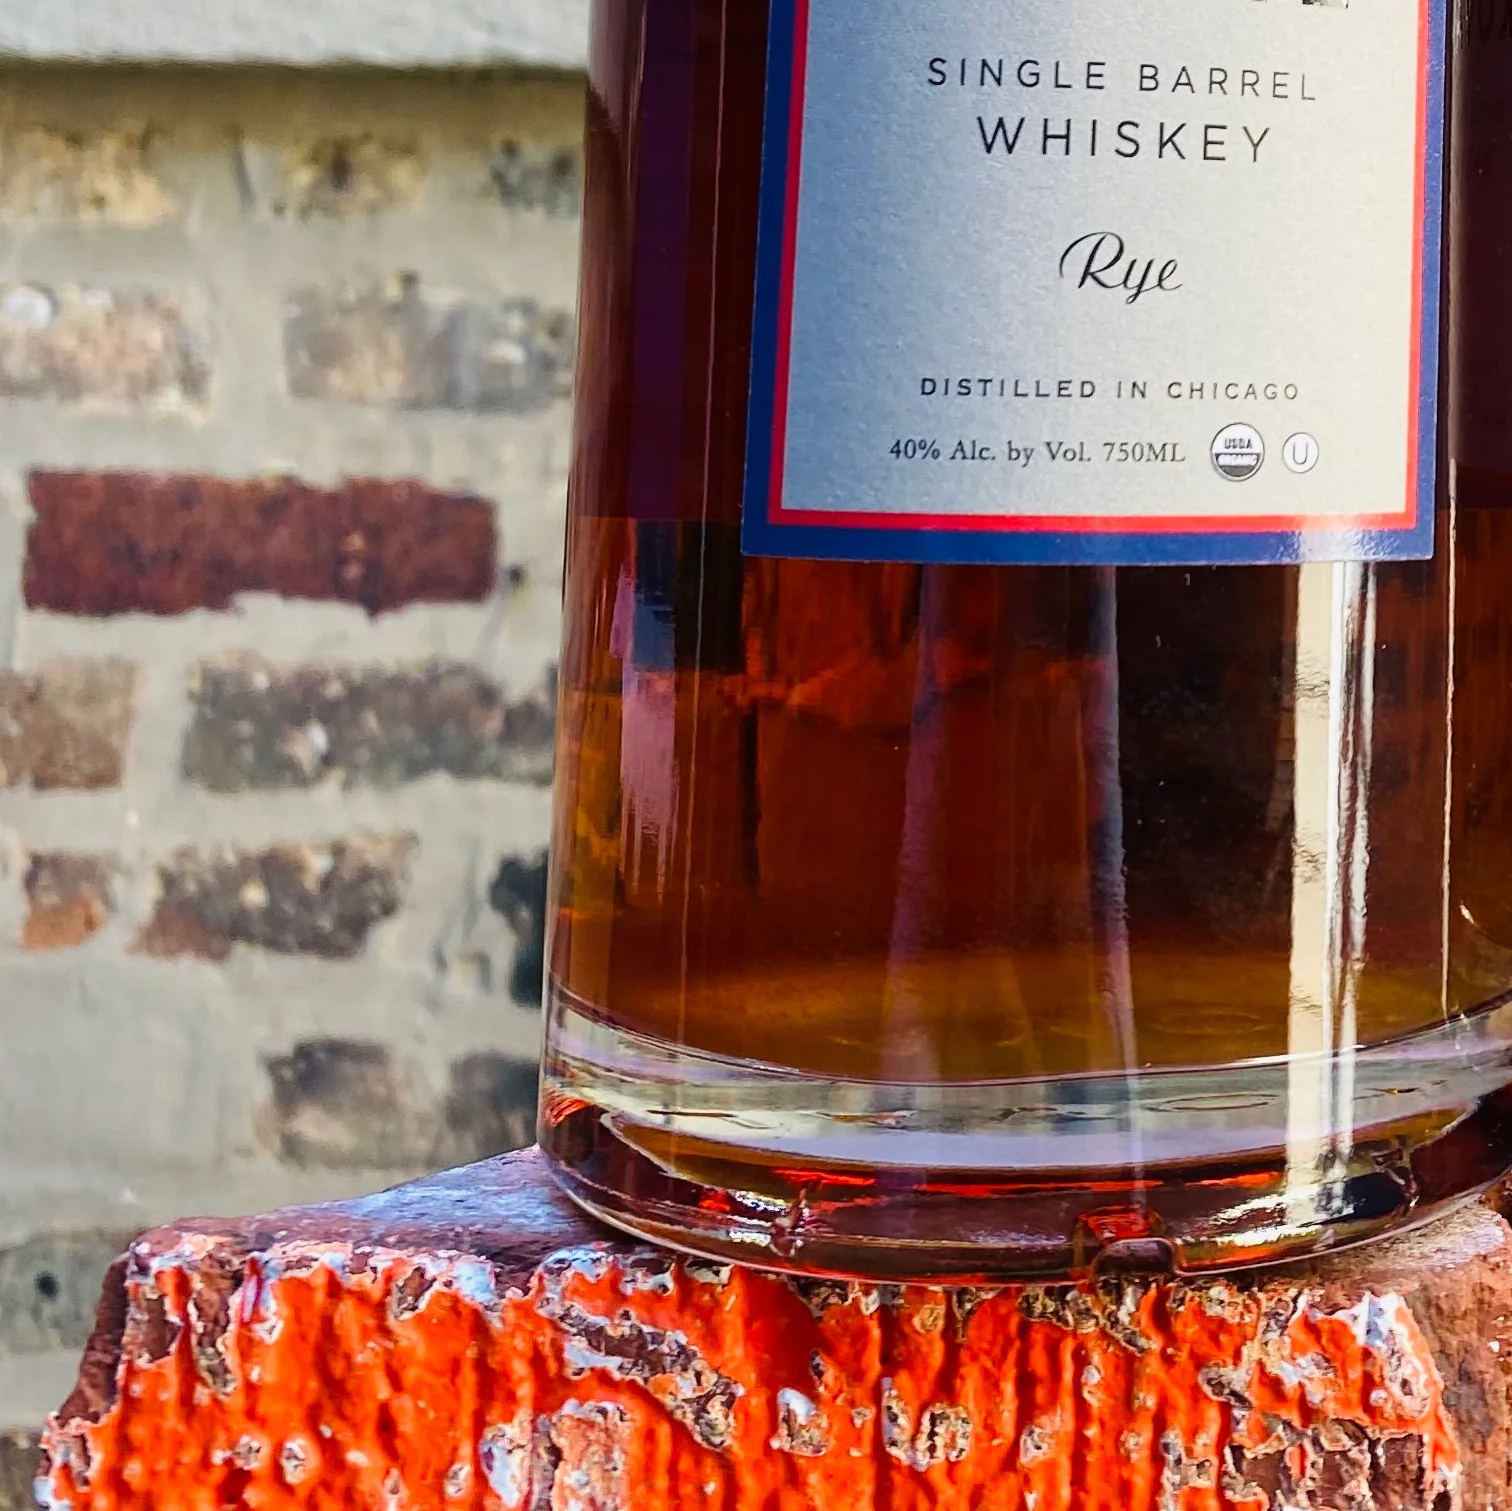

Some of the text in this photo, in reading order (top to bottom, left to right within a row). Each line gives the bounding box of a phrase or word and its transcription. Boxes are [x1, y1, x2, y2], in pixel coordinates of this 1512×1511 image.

[926, 56, 1316, 101] SINGLE BARREL
[975, 115, 1271, 164] WHISKEY
[1059, 232, 1183, 305] Rye
[920, 377, 1298, 401] DISTILLED IN CHICAGO
[888, 438, 1187, 469] 40% Alc. by Vol. 750ML
